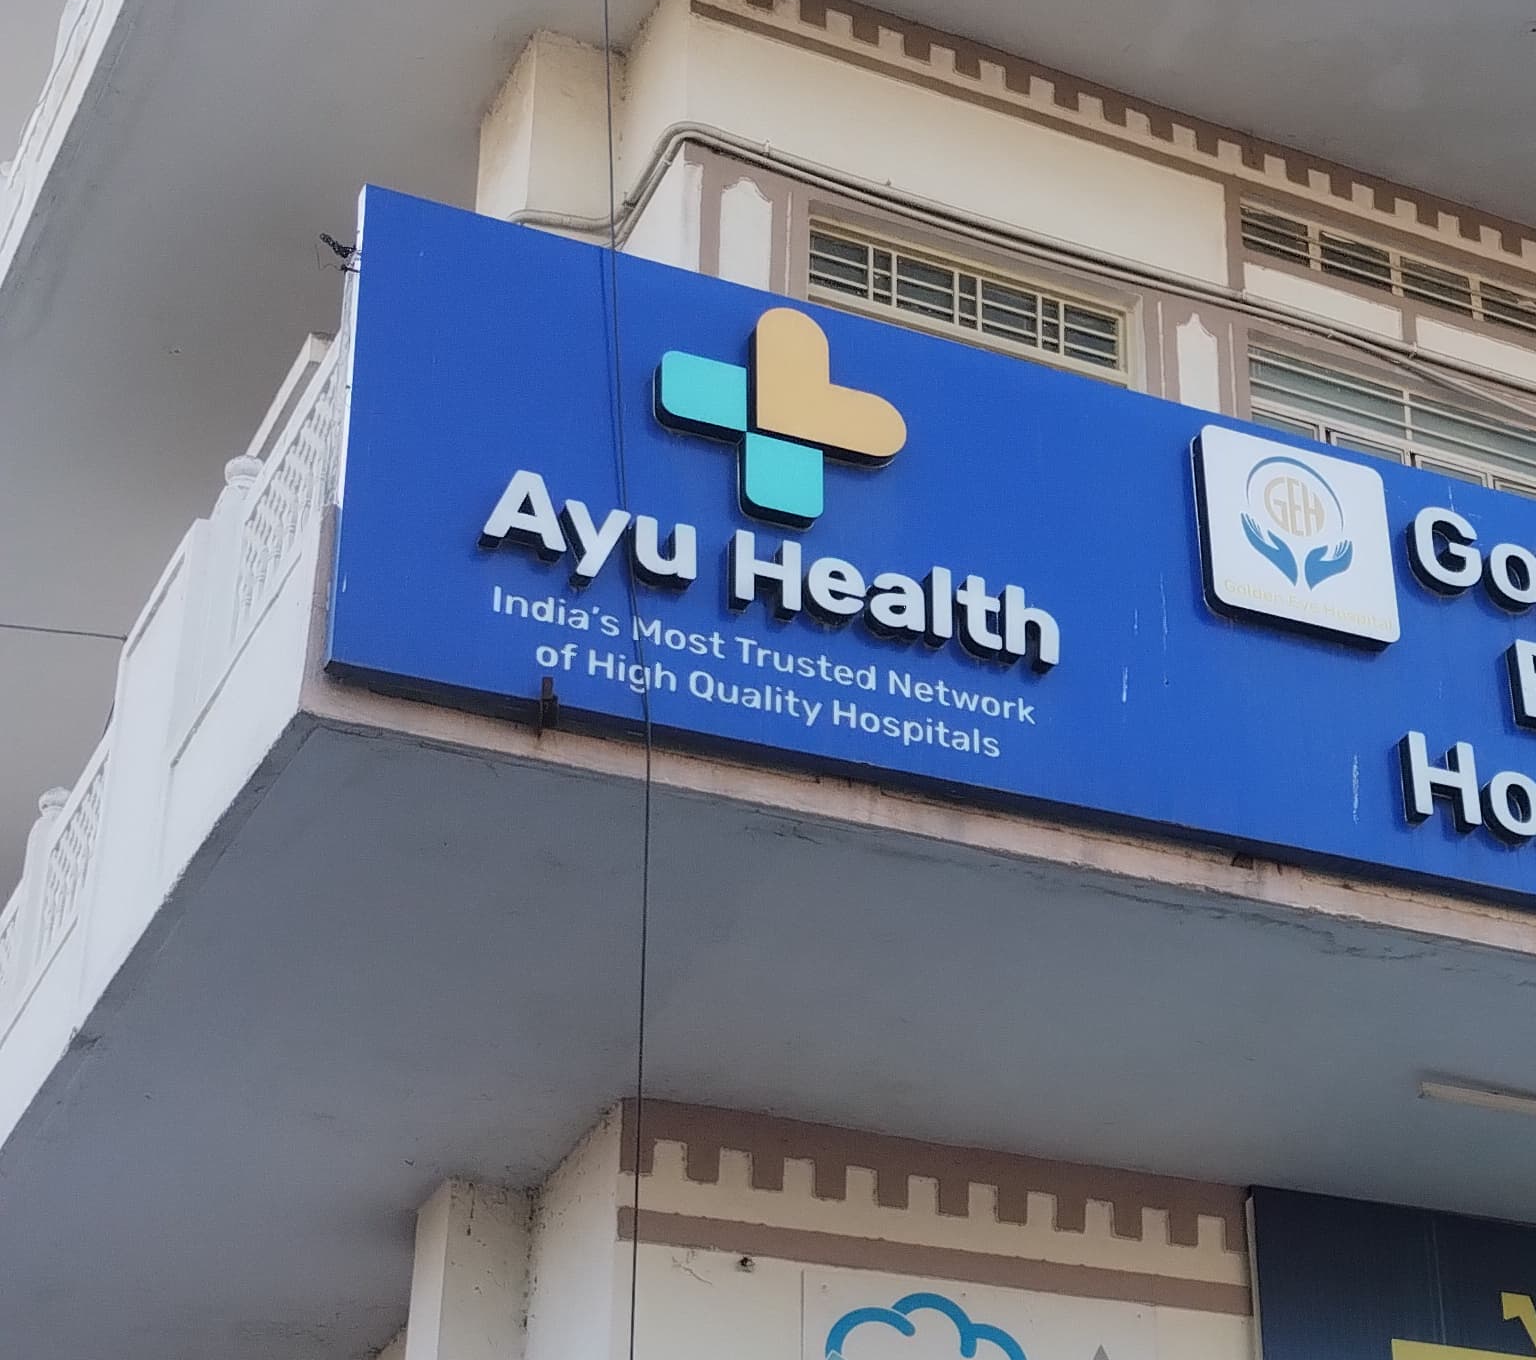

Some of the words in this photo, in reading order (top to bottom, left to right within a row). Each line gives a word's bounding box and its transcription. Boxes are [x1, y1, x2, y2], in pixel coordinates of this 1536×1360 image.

[479, 469, 698, 583] Ayu
[730, 528, 1061, 670] Health
[492, 585, 621, 638] India's
[633, 615, 726, 660] Most
[735, 635, 878, 691] Trusted
[888, 669, 1036, 725] Network
[536, 643, 578, 670] of
[588, 648, 677, 694] High
[689, 670, 824, 727] Quality
[832, 699, 1002, 758] Hospitals
